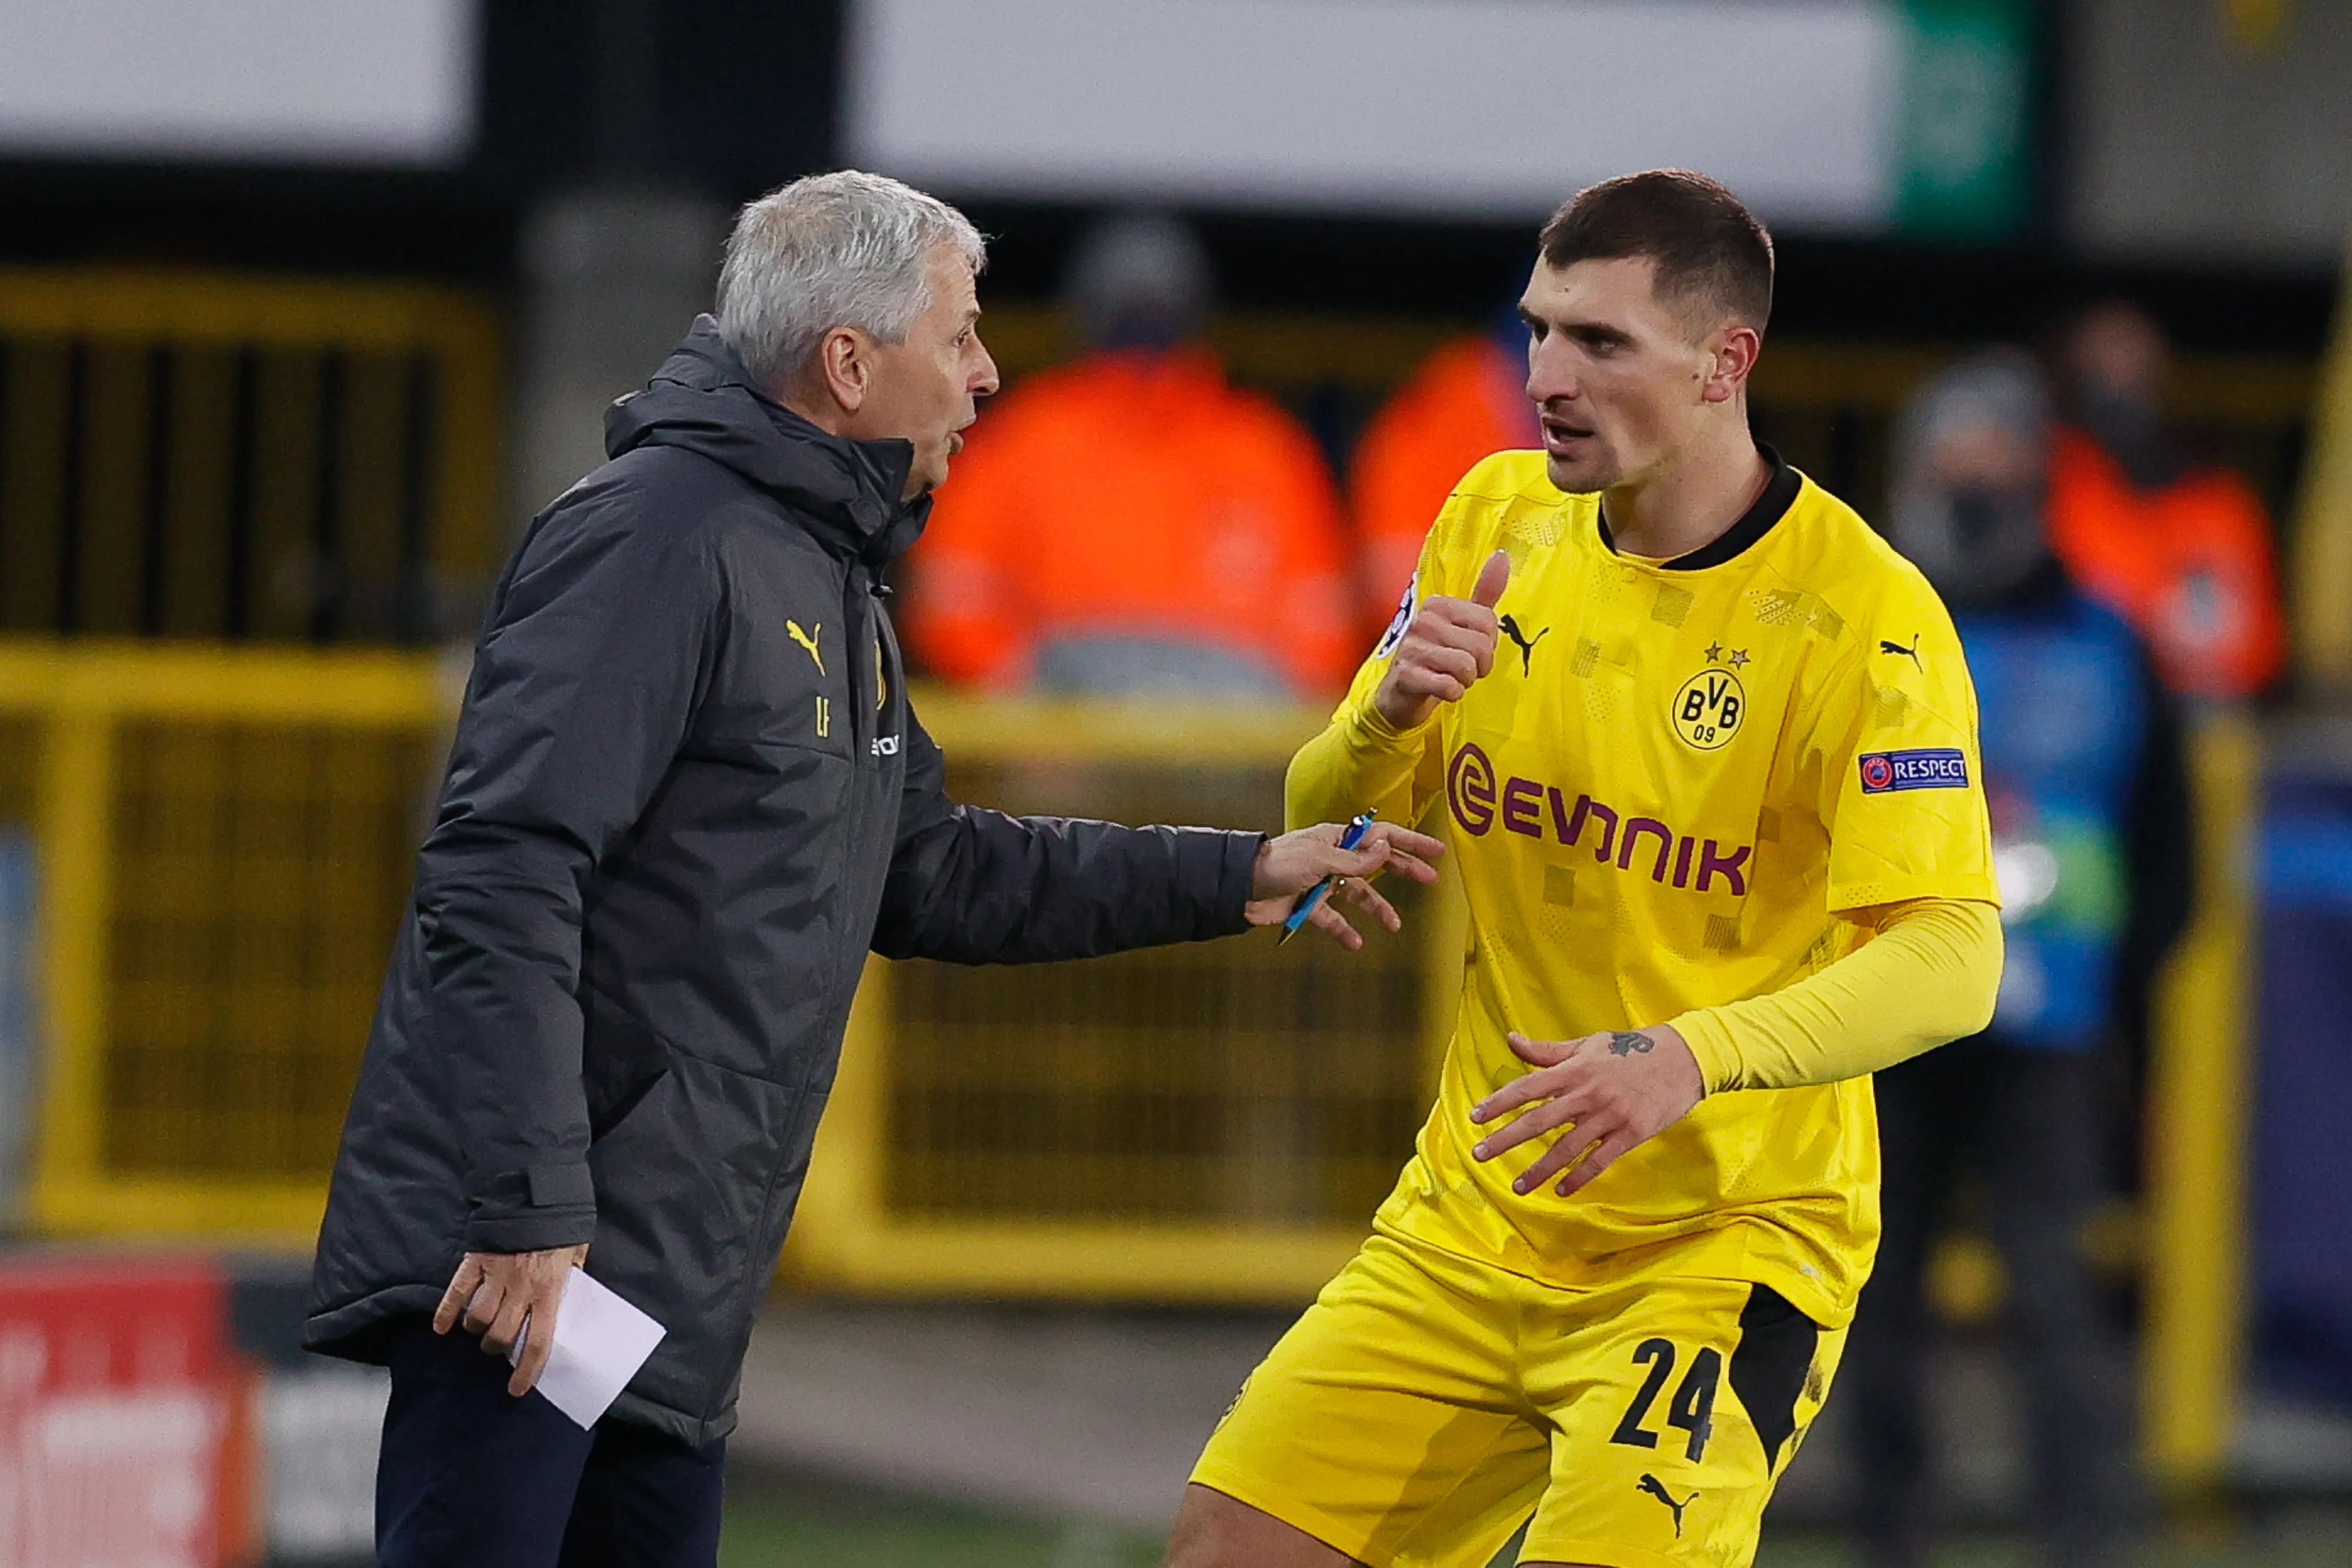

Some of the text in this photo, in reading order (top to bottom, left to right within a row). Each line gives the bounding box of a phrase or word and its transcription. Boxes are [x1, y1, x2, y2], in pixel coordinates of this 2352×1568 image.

[1681, 676, 1739, 729] BVB
[1693, 724, 1716, 743] 09
[1893, 759, 1965, 779] RESPECT
[1608, 1337, 1722, 1465] 24
